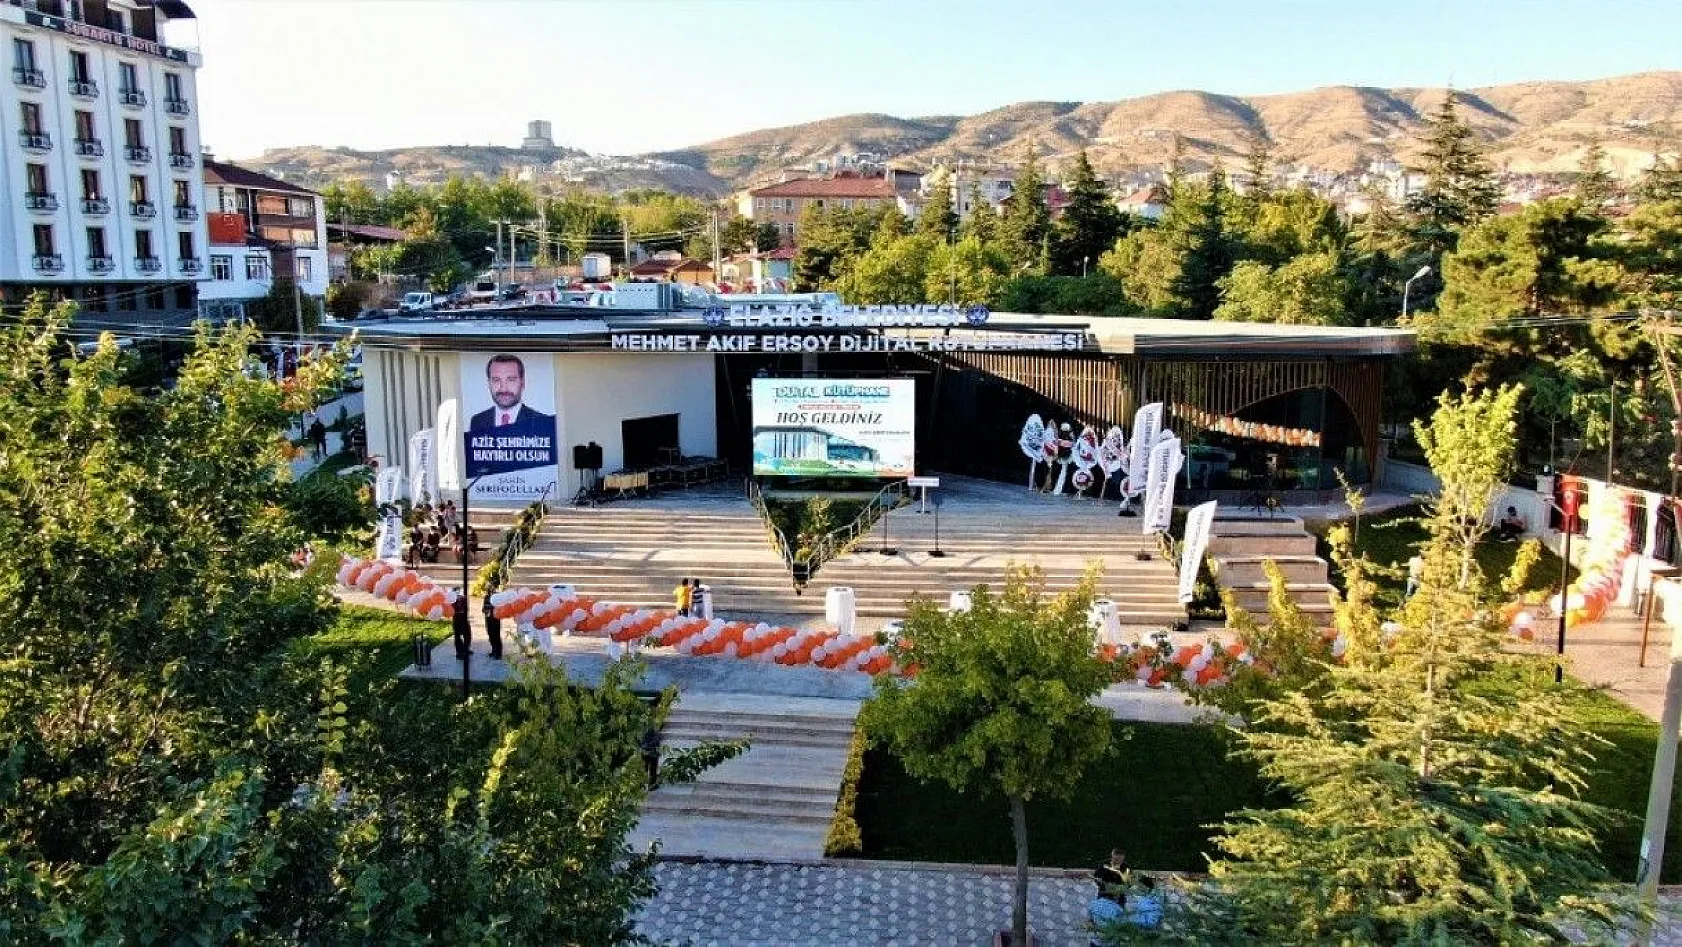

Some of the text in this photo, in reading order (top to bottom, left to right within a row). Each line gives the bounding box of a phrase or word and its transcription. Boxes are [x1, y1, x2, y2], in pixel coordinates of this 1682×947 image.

[611, 334, 700, 352] MEHMET
[761, 334, 833, 352] ERSOY
[840, 334, 922, 352] DİJİTAL
[776, 411, 883, 426] HOŞ GELDİNİZ
[472, 435, 551, 449] AZİZ ŞEHRİMİZE
[473, 449, 550, 462] HAYIRLI OLSUN
